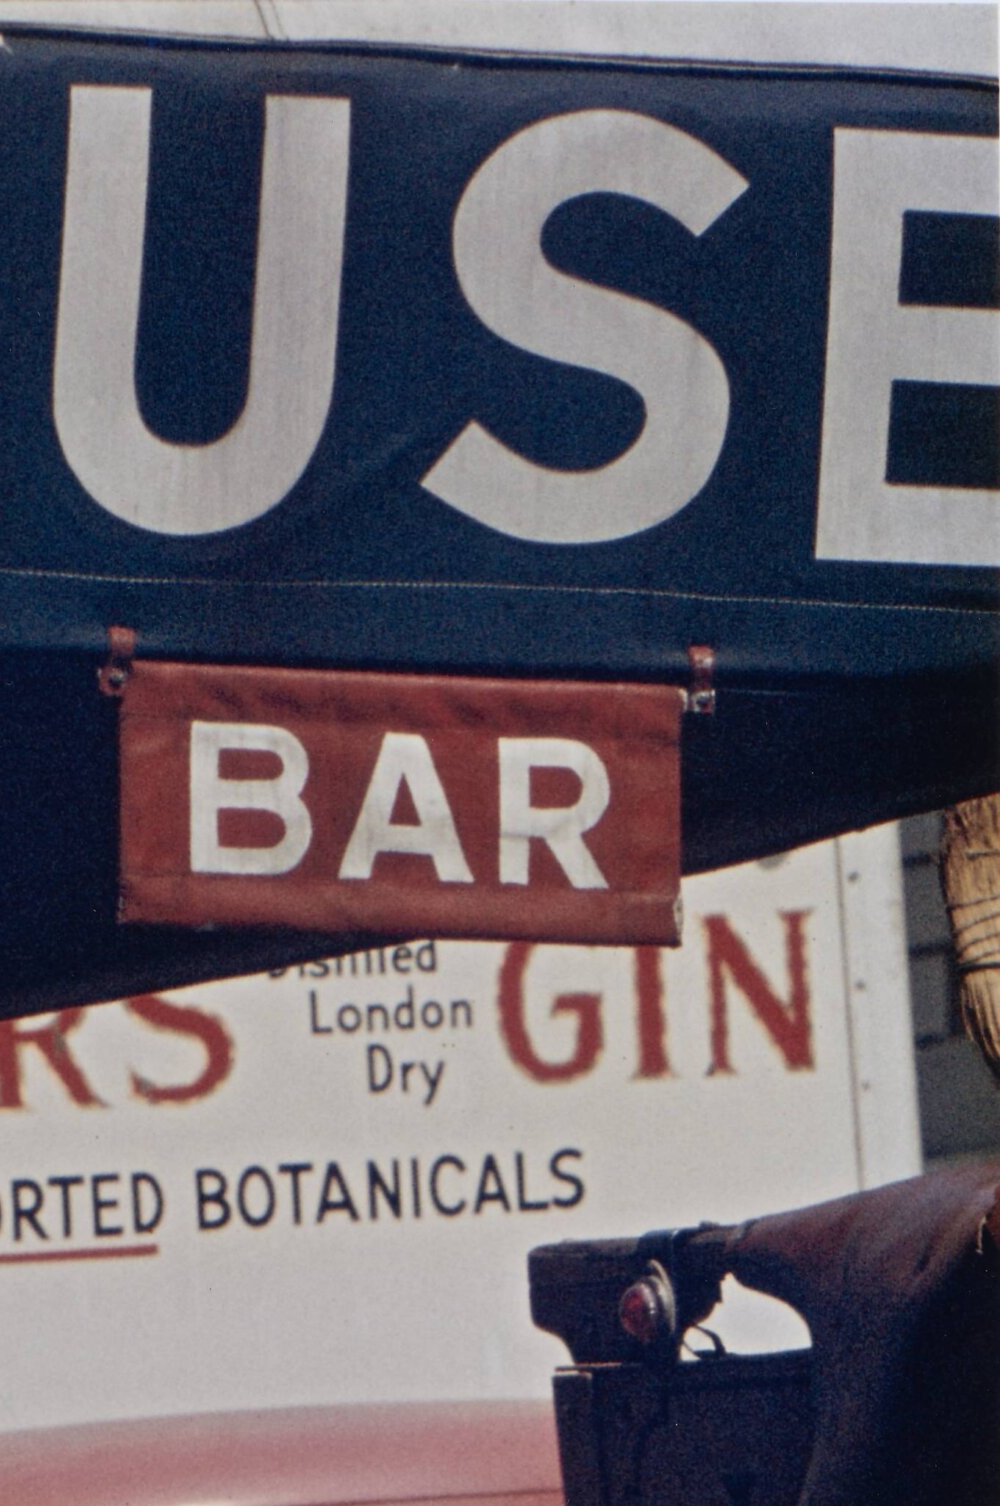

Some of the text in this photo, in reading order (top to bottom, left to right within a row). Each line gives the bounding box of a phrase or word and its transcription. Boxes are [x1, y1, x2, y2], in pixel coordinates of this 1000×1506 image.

[190, 721, 610, 888] BAR
[309, 984, 473, 1034] London
[498, 909, 816, 1084] GIN
[367, 1043, 446, 1106] Dry
[196, 1148, 585, 1230] BOTANICALS
